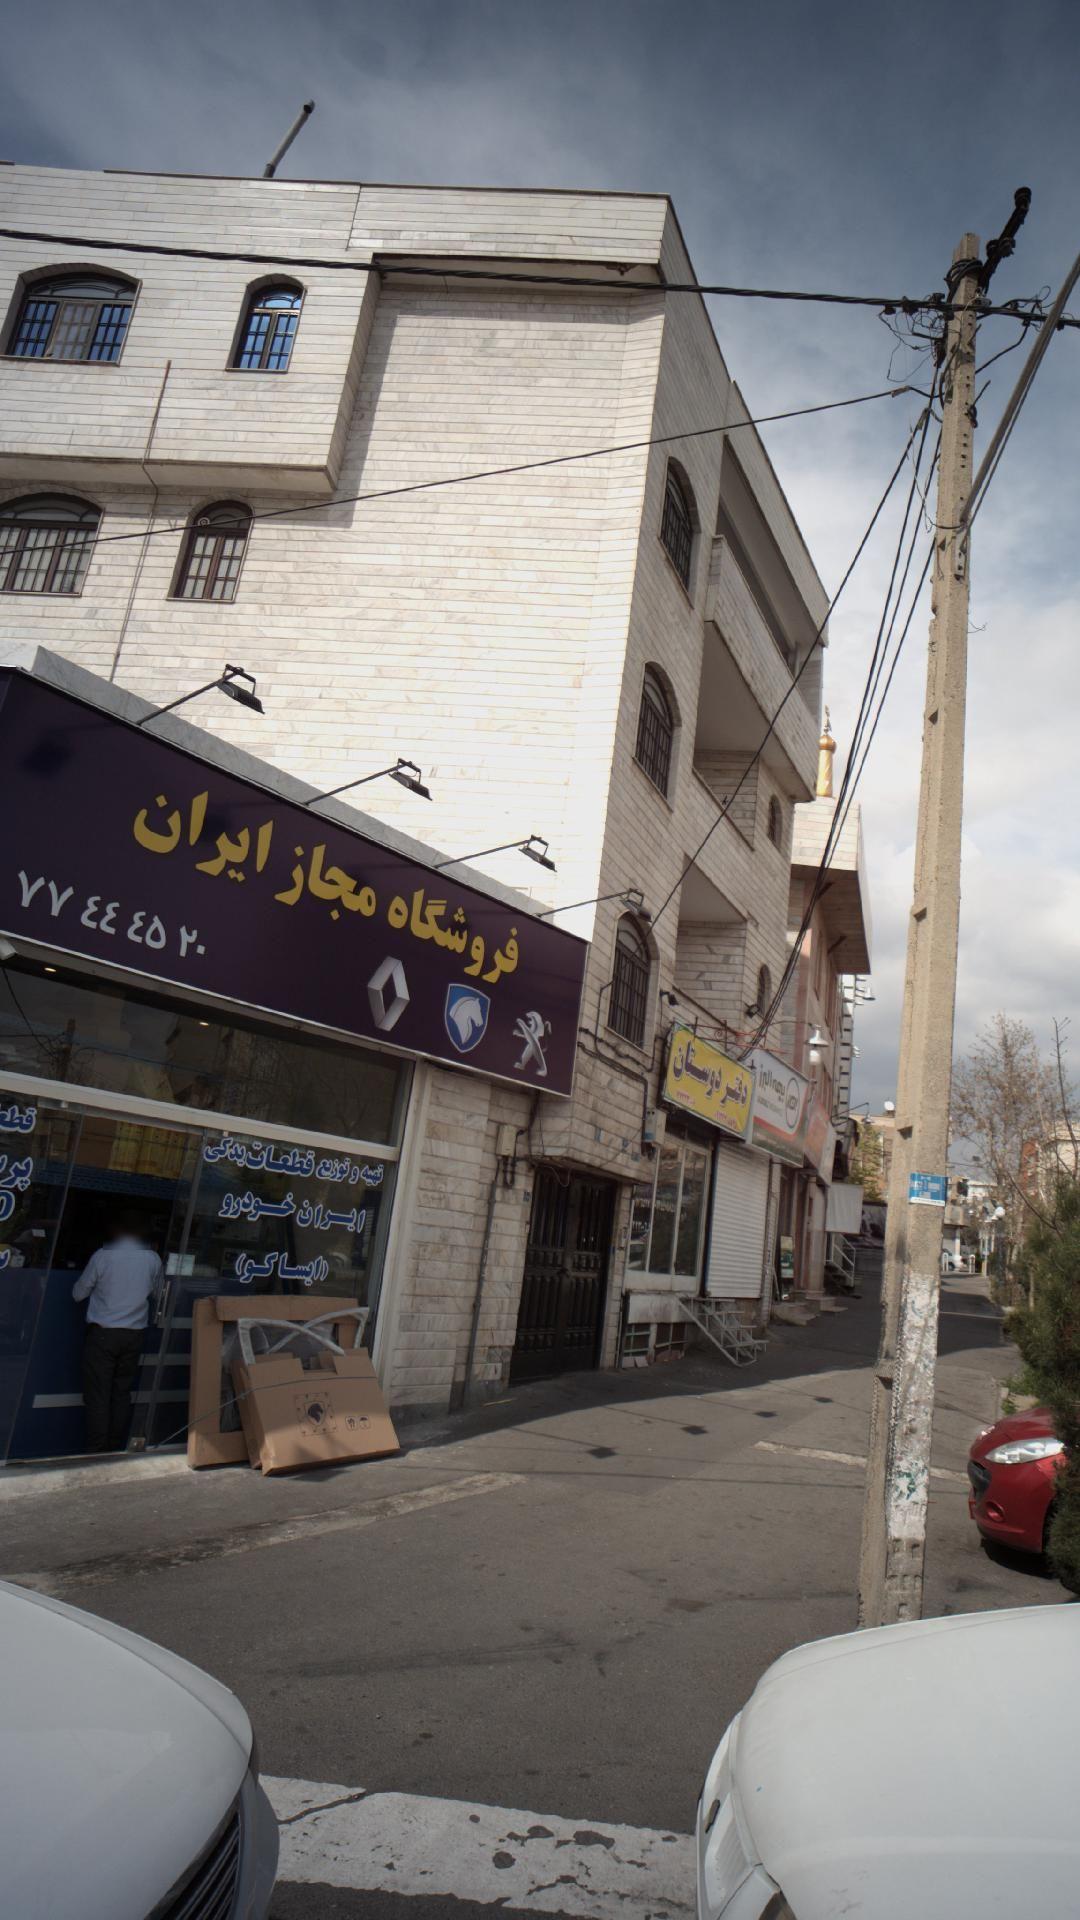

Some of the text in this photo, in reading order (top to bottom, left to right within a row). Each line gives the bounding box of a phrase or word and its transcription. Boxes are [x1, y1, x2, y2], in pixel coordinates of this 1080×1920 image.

[133, 790, 519, 984] فروشگاه مجاز ایران
[203, 1138, 247, 1168] یدکی
[246, 1140, 316, 1177] قطعات
[316, 1157, 351, 1182] توزیع
[218, 1191, 366, 1234] ایران خودرو
